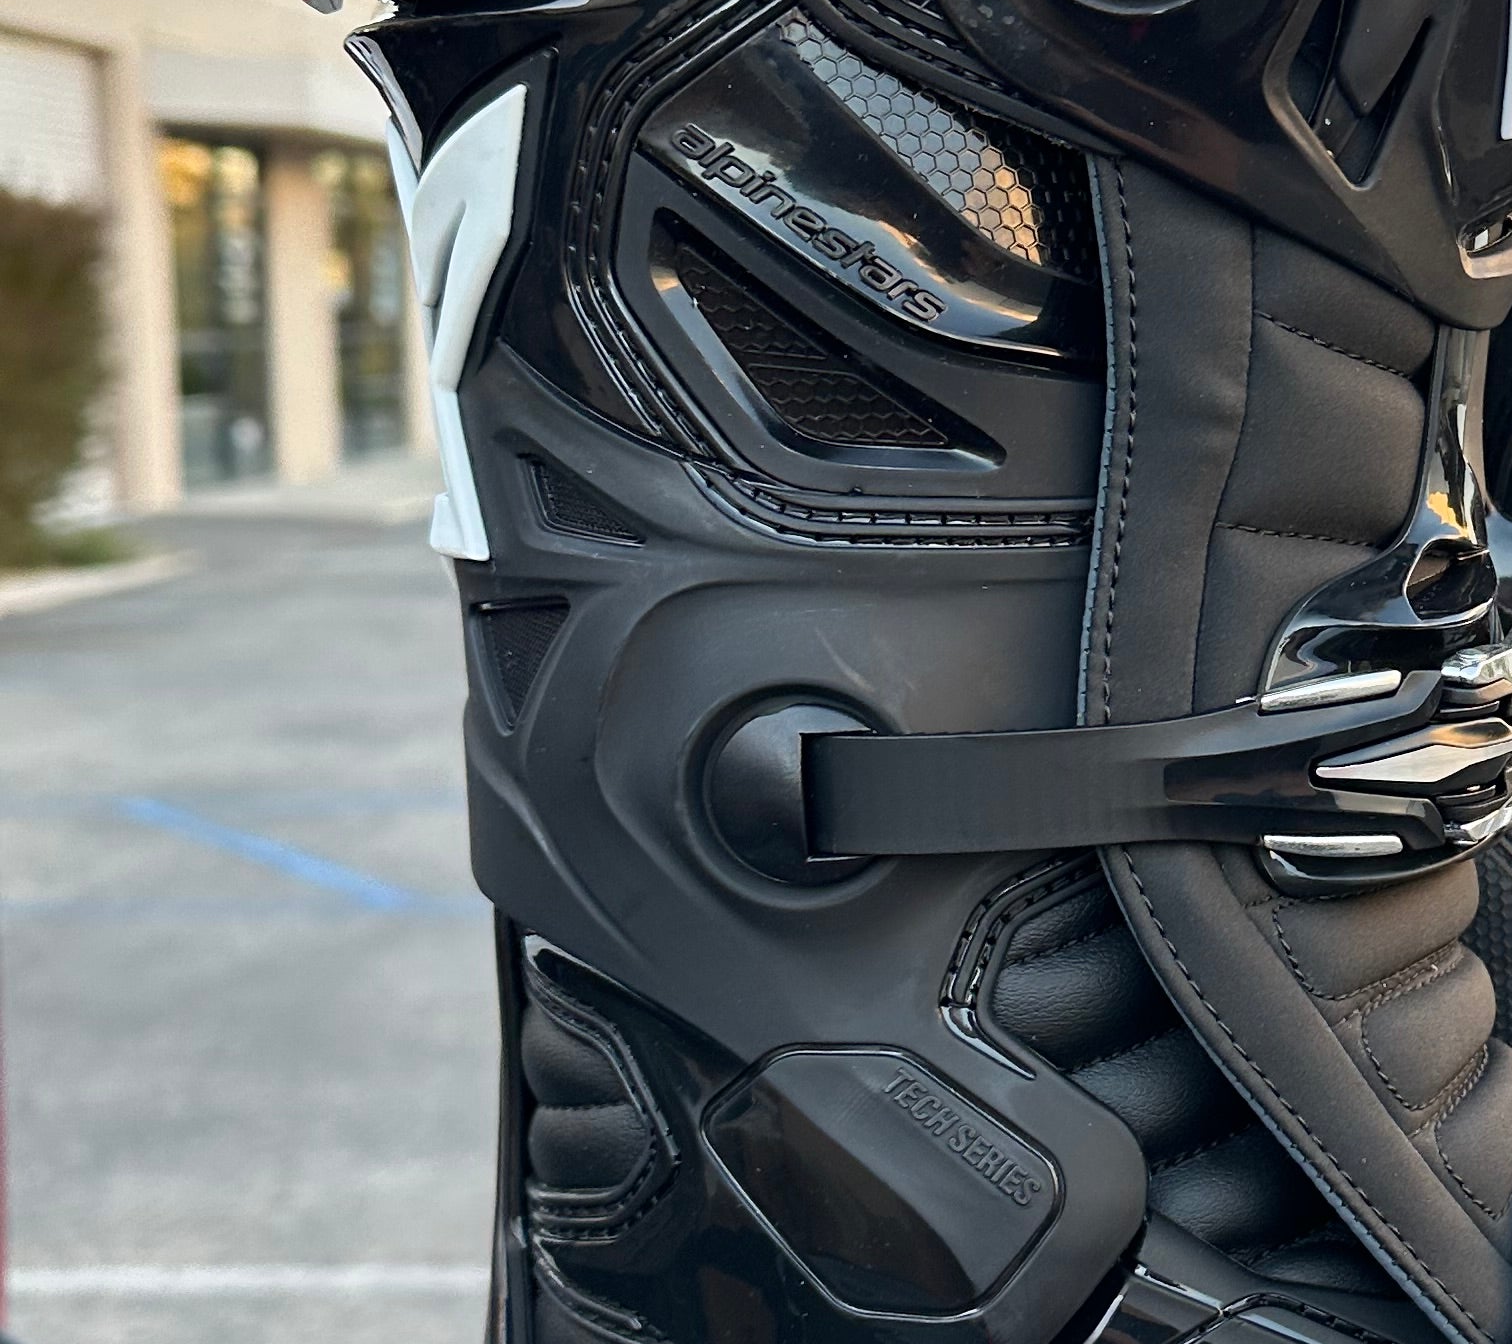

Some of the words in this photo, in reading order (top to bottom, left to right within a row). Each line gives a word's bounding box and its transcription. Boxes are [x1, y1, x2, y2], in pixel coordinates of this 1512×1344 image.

[671, 123, 947, 322] alpinestars
[884, 1067, 960, 1136] TECH
[949, 1124, 1041, 1205] SERIES
